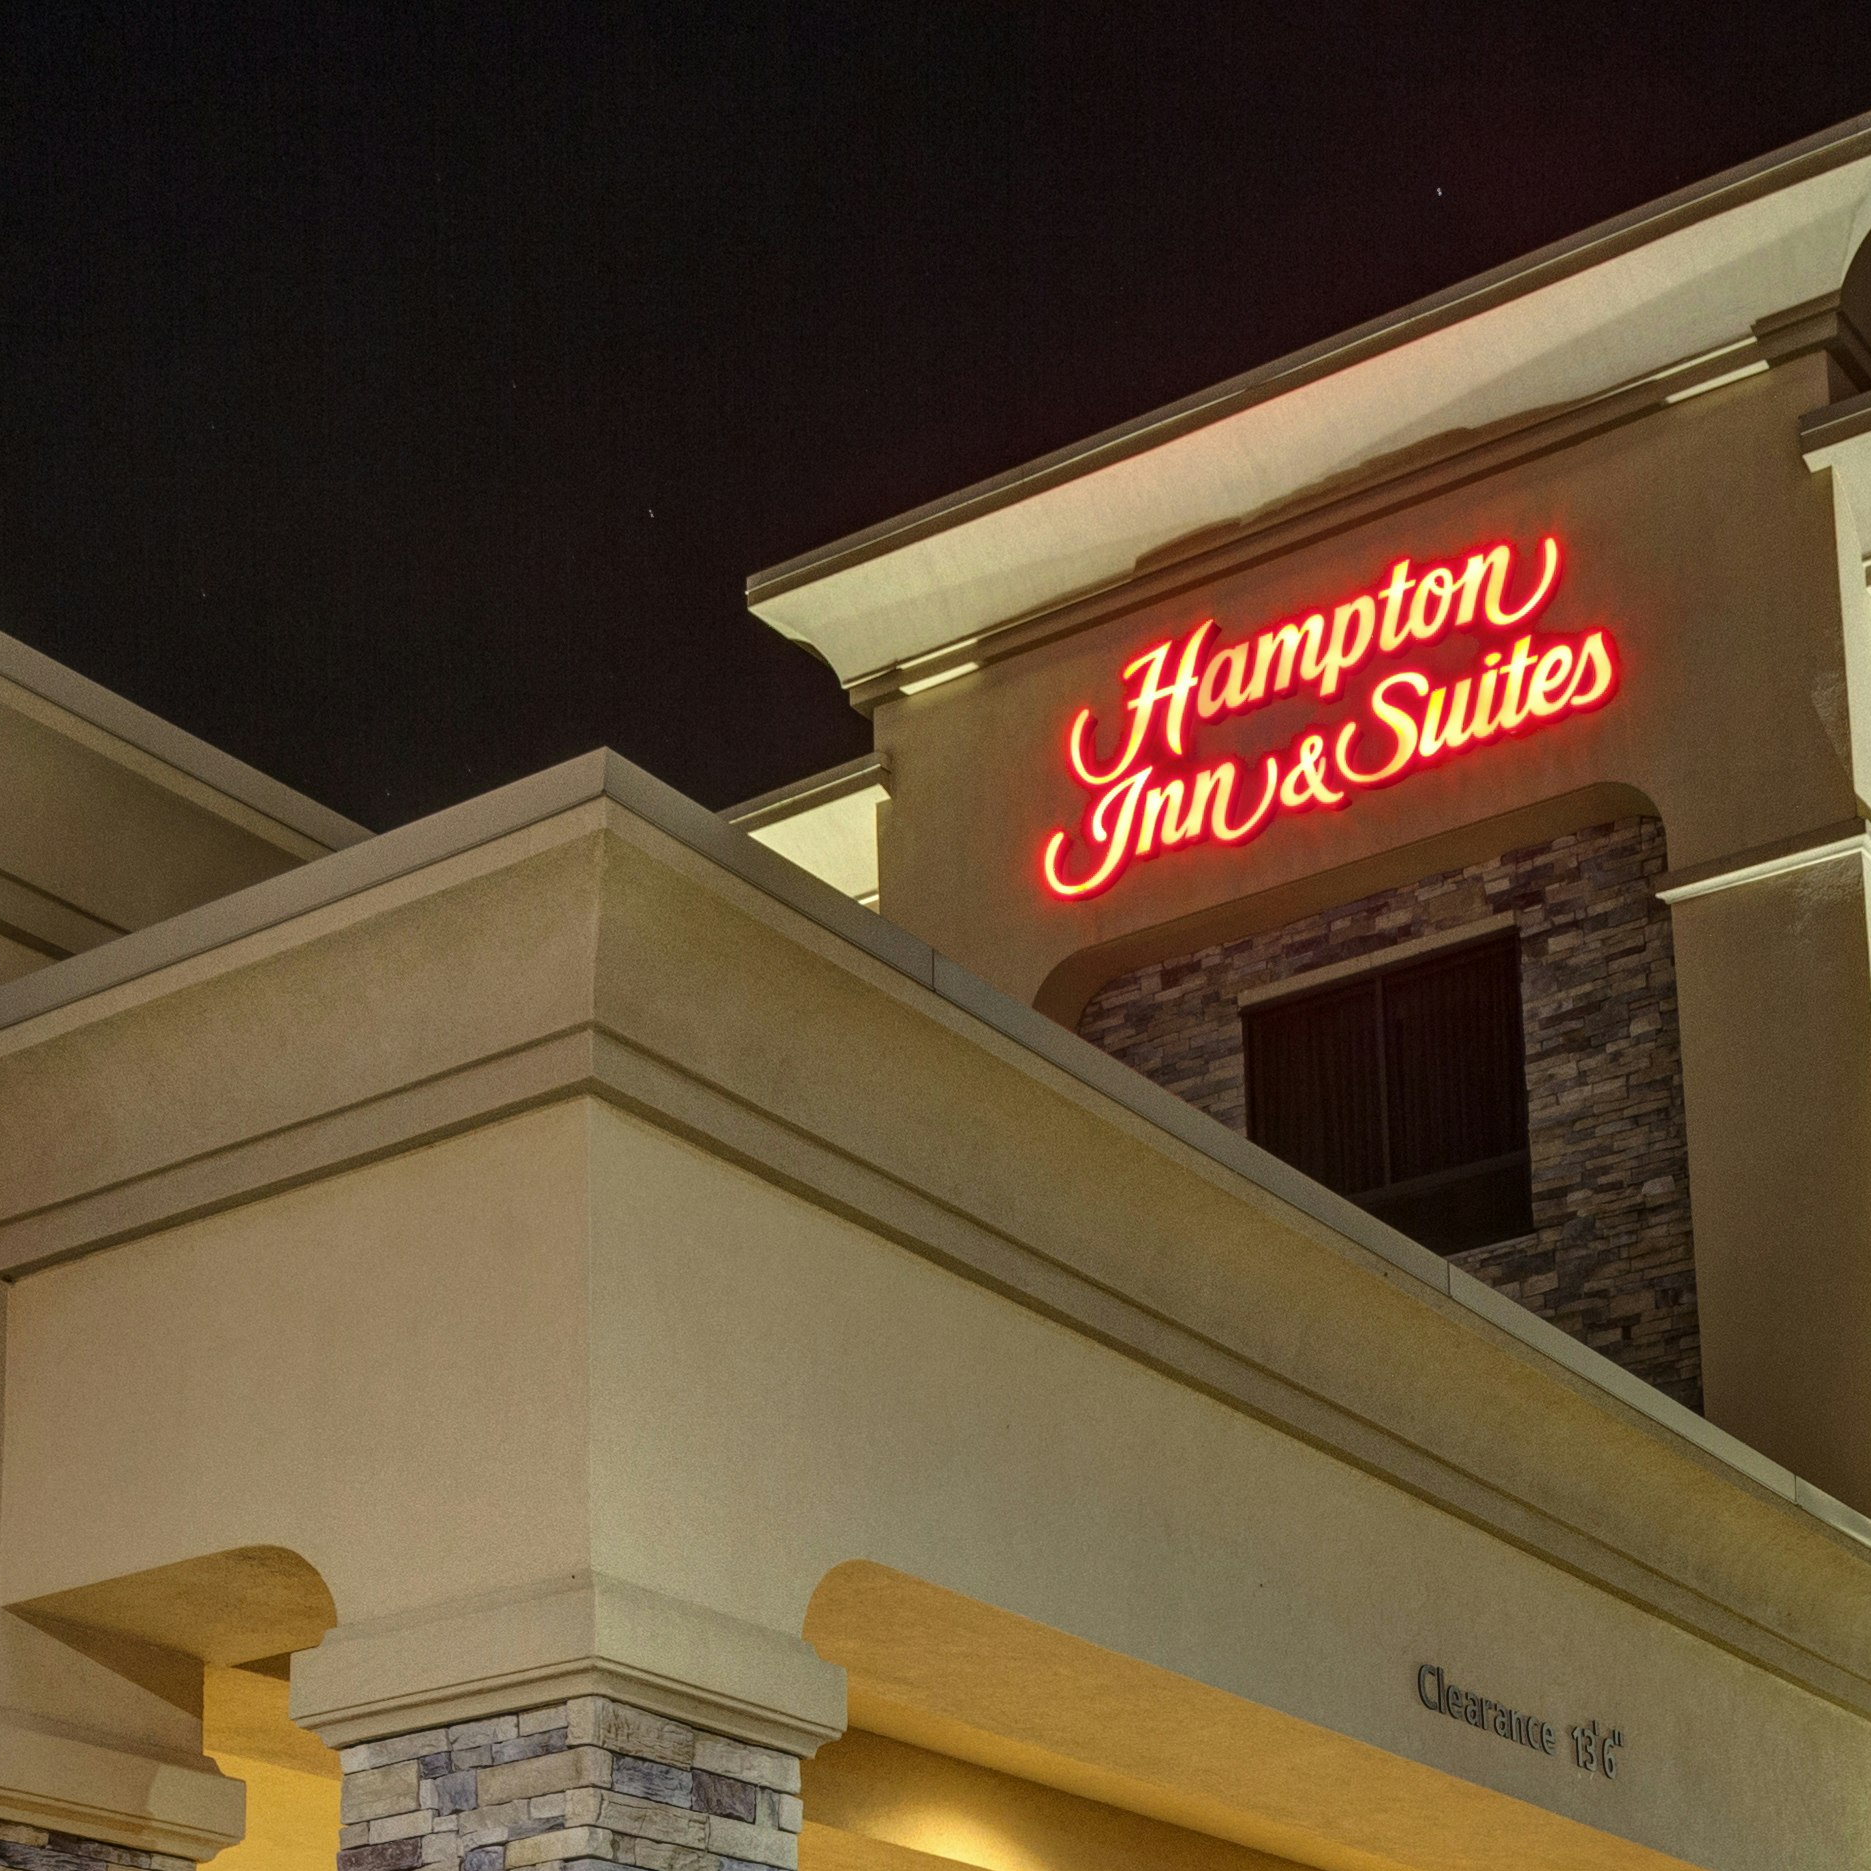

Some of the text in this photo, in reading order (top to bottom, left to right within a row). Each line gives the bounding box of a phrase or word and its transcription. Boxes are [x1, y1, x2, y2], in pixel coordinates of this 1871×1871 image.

[1043, 631, 1613, 896] Inn & Suites
[1069, 536, 1558, 786] Hampton
[1417, 1663, 1557, 1756] Clearance
